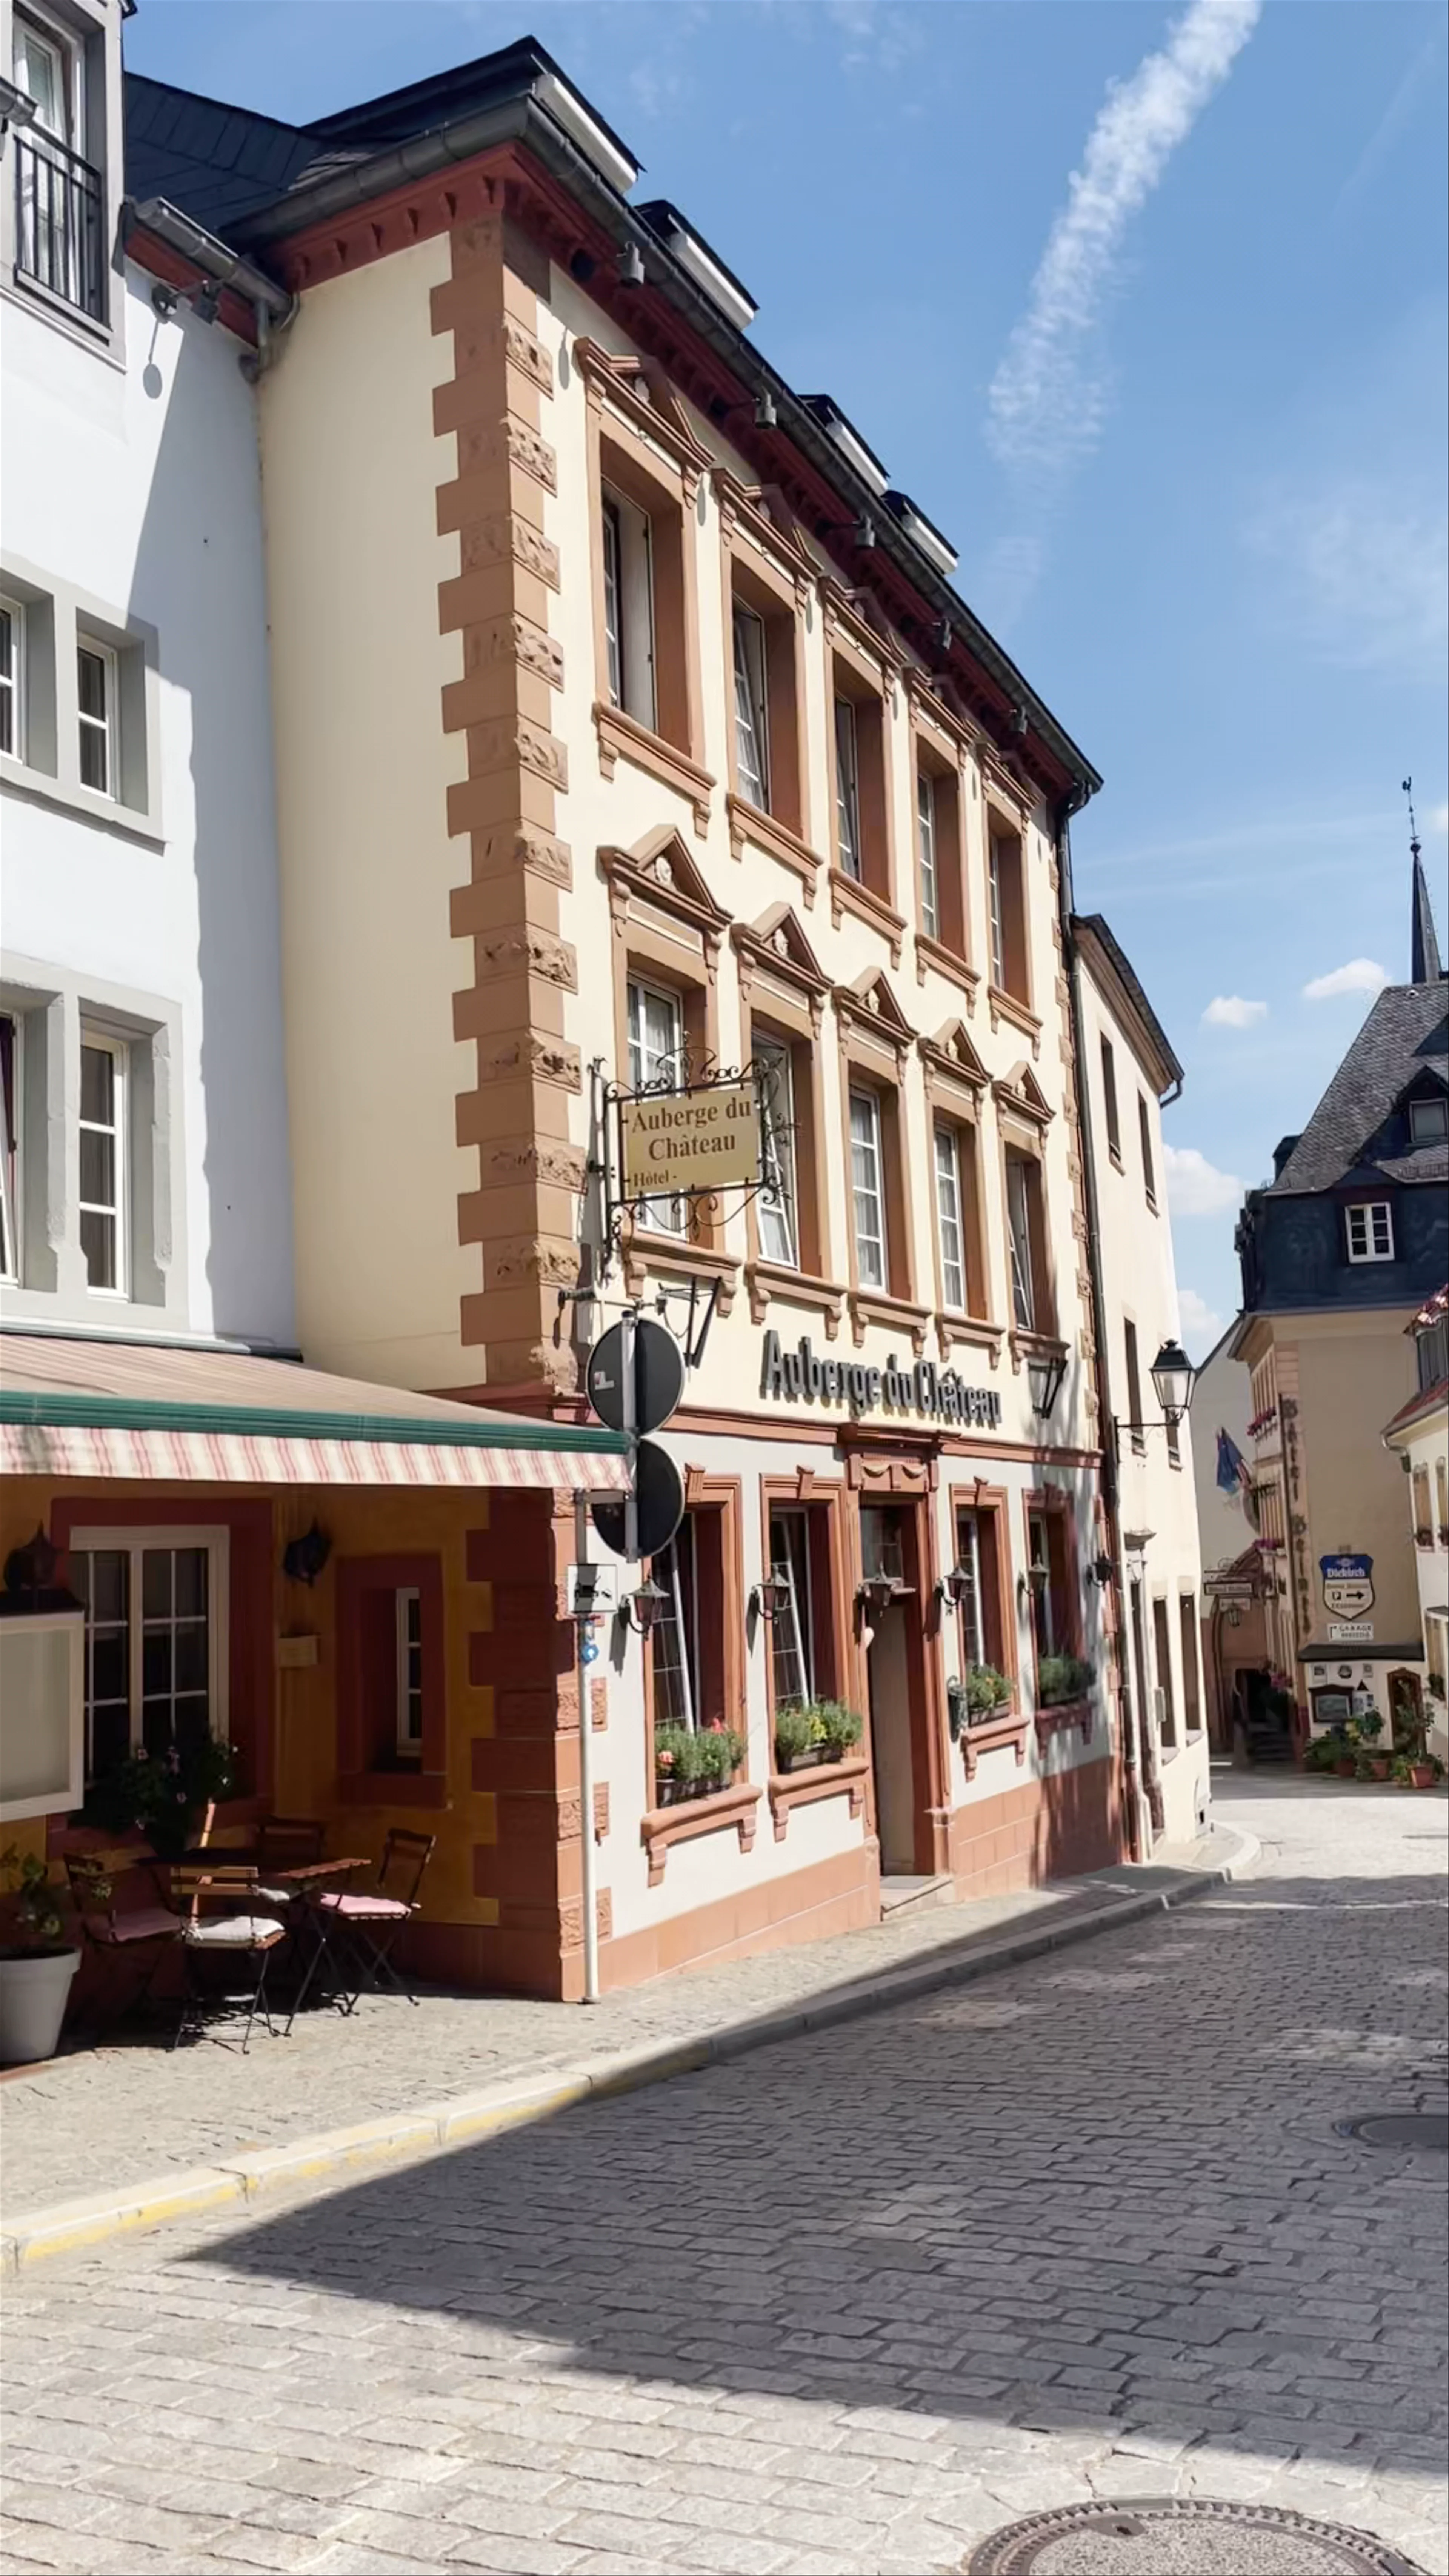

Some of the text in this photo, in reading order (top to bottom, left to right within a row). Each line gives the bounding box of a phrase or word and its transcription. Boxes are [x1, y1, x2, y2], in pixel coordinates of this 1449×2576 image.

[632, 1097, 751, 1133] Auberge du
[648, 1134, 735, 1161] Château
[762, 1330, 1002, 1424] Auberge du Château
